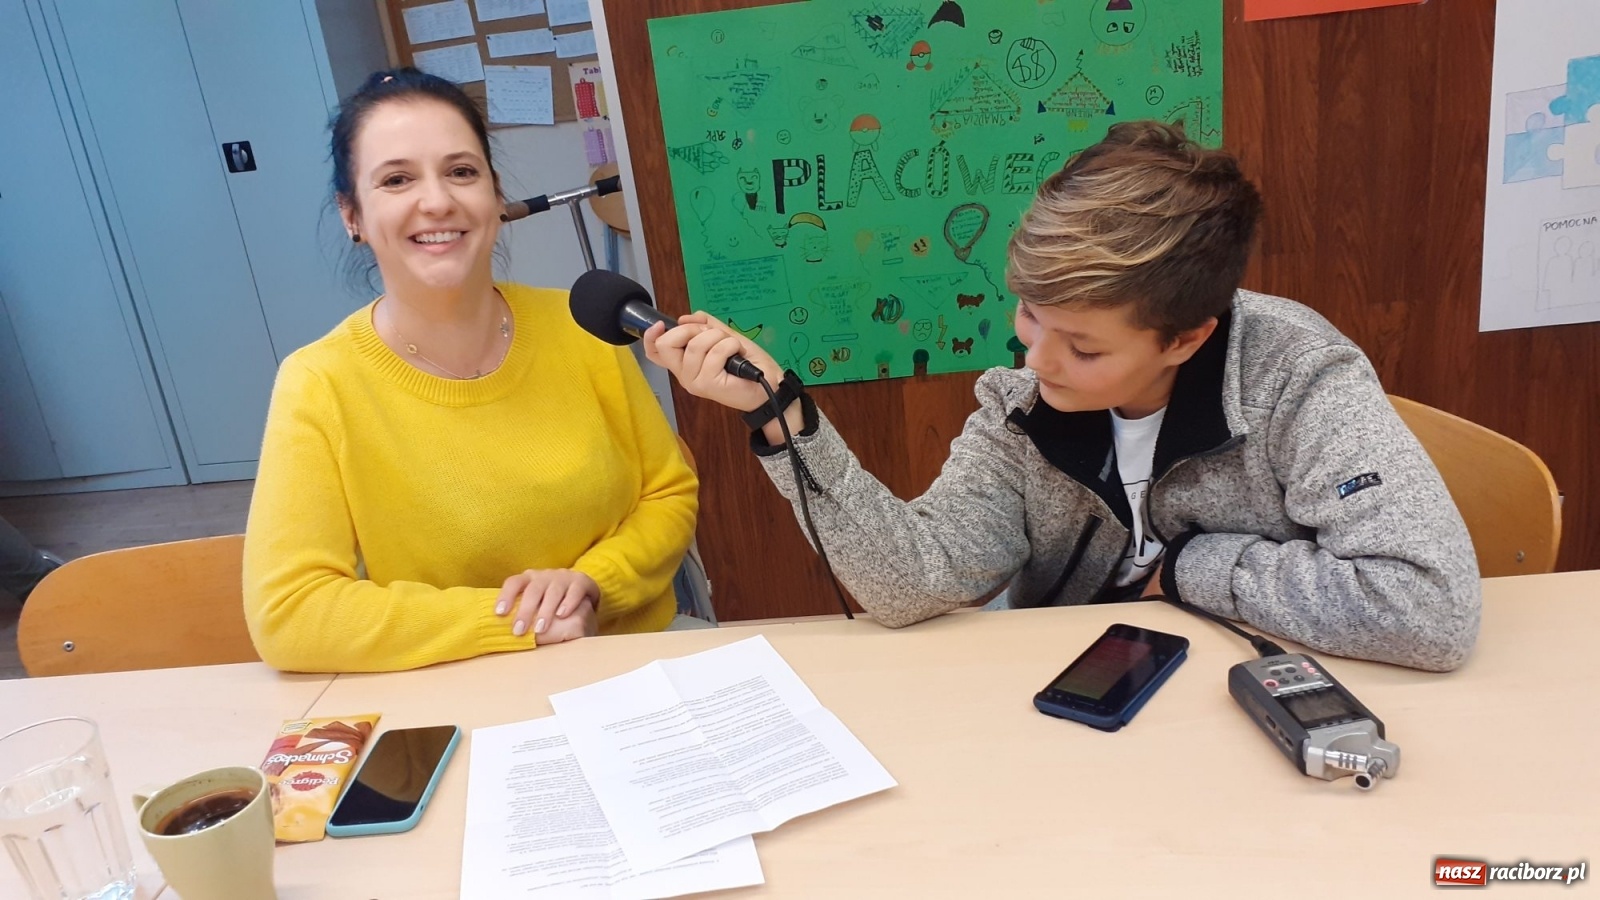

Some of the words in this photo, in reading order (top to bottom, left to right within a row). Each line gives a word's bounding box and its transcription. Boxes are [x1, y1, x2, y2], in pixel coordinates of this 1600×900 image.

[963, 114, 1000, 127] MADZIA
[772, 140, 1082, 214] PLACÓWEC
[872, 293, 905, 324] XD
[264, 750, 353, 768] Schmackos
[279, 777, 340, 786] Pedigree
